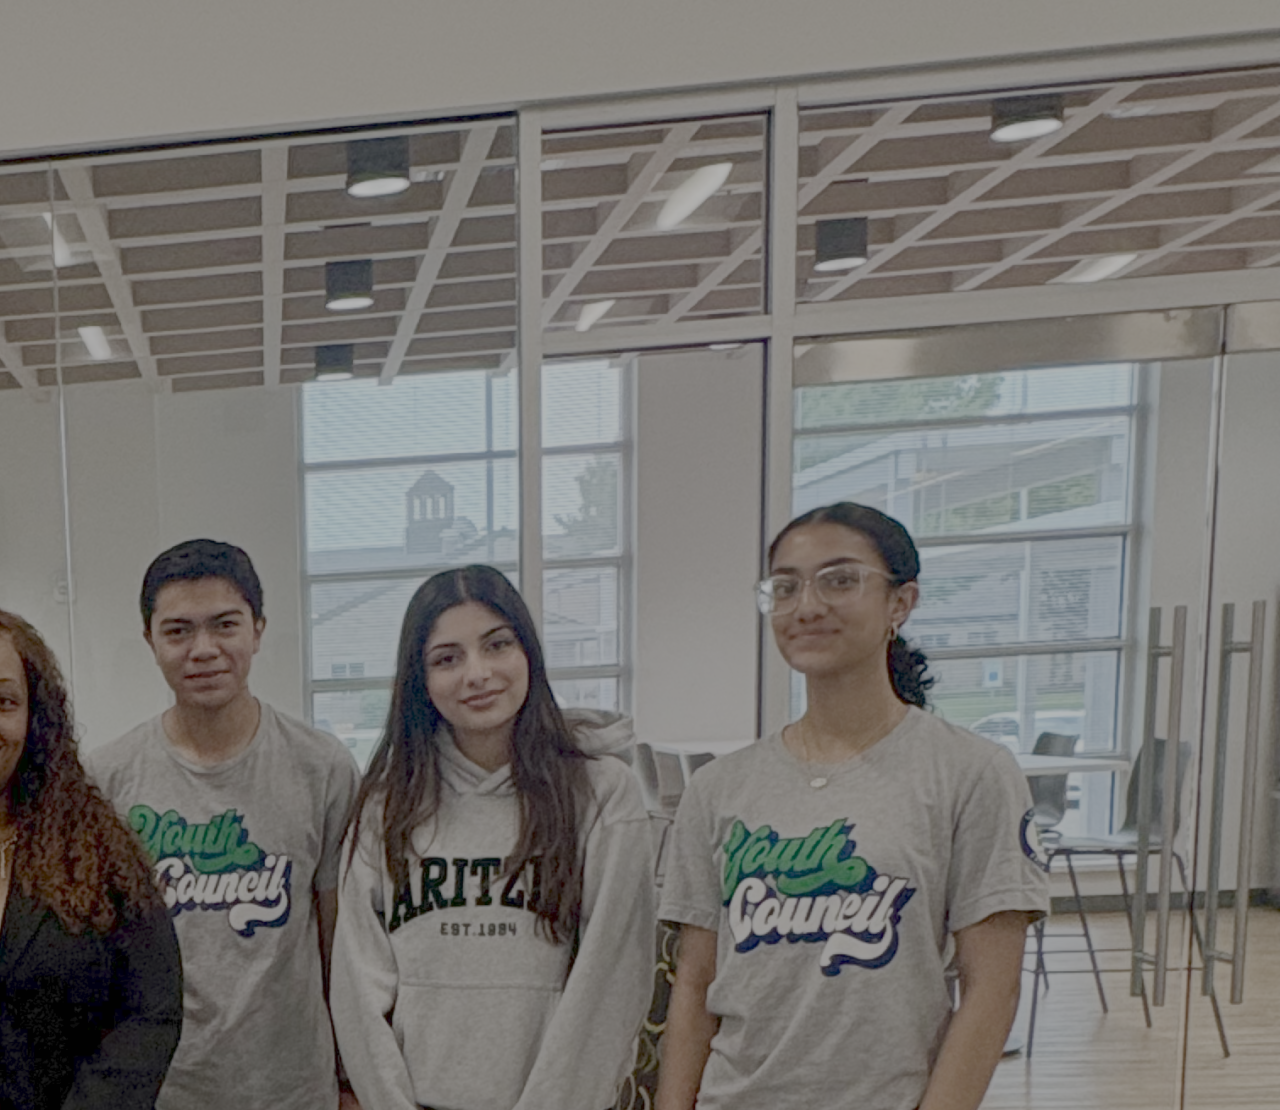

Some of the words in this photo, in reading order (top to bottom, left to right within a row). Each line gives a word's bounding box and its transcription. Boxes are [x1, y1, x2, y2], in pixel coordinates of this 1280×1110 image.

[127, 803, 266, 875] Youth
[722, 816, 876, 907] Youth
[387, 857, 544, 935] ARITZI
[727, 875, 918, 978] Council
